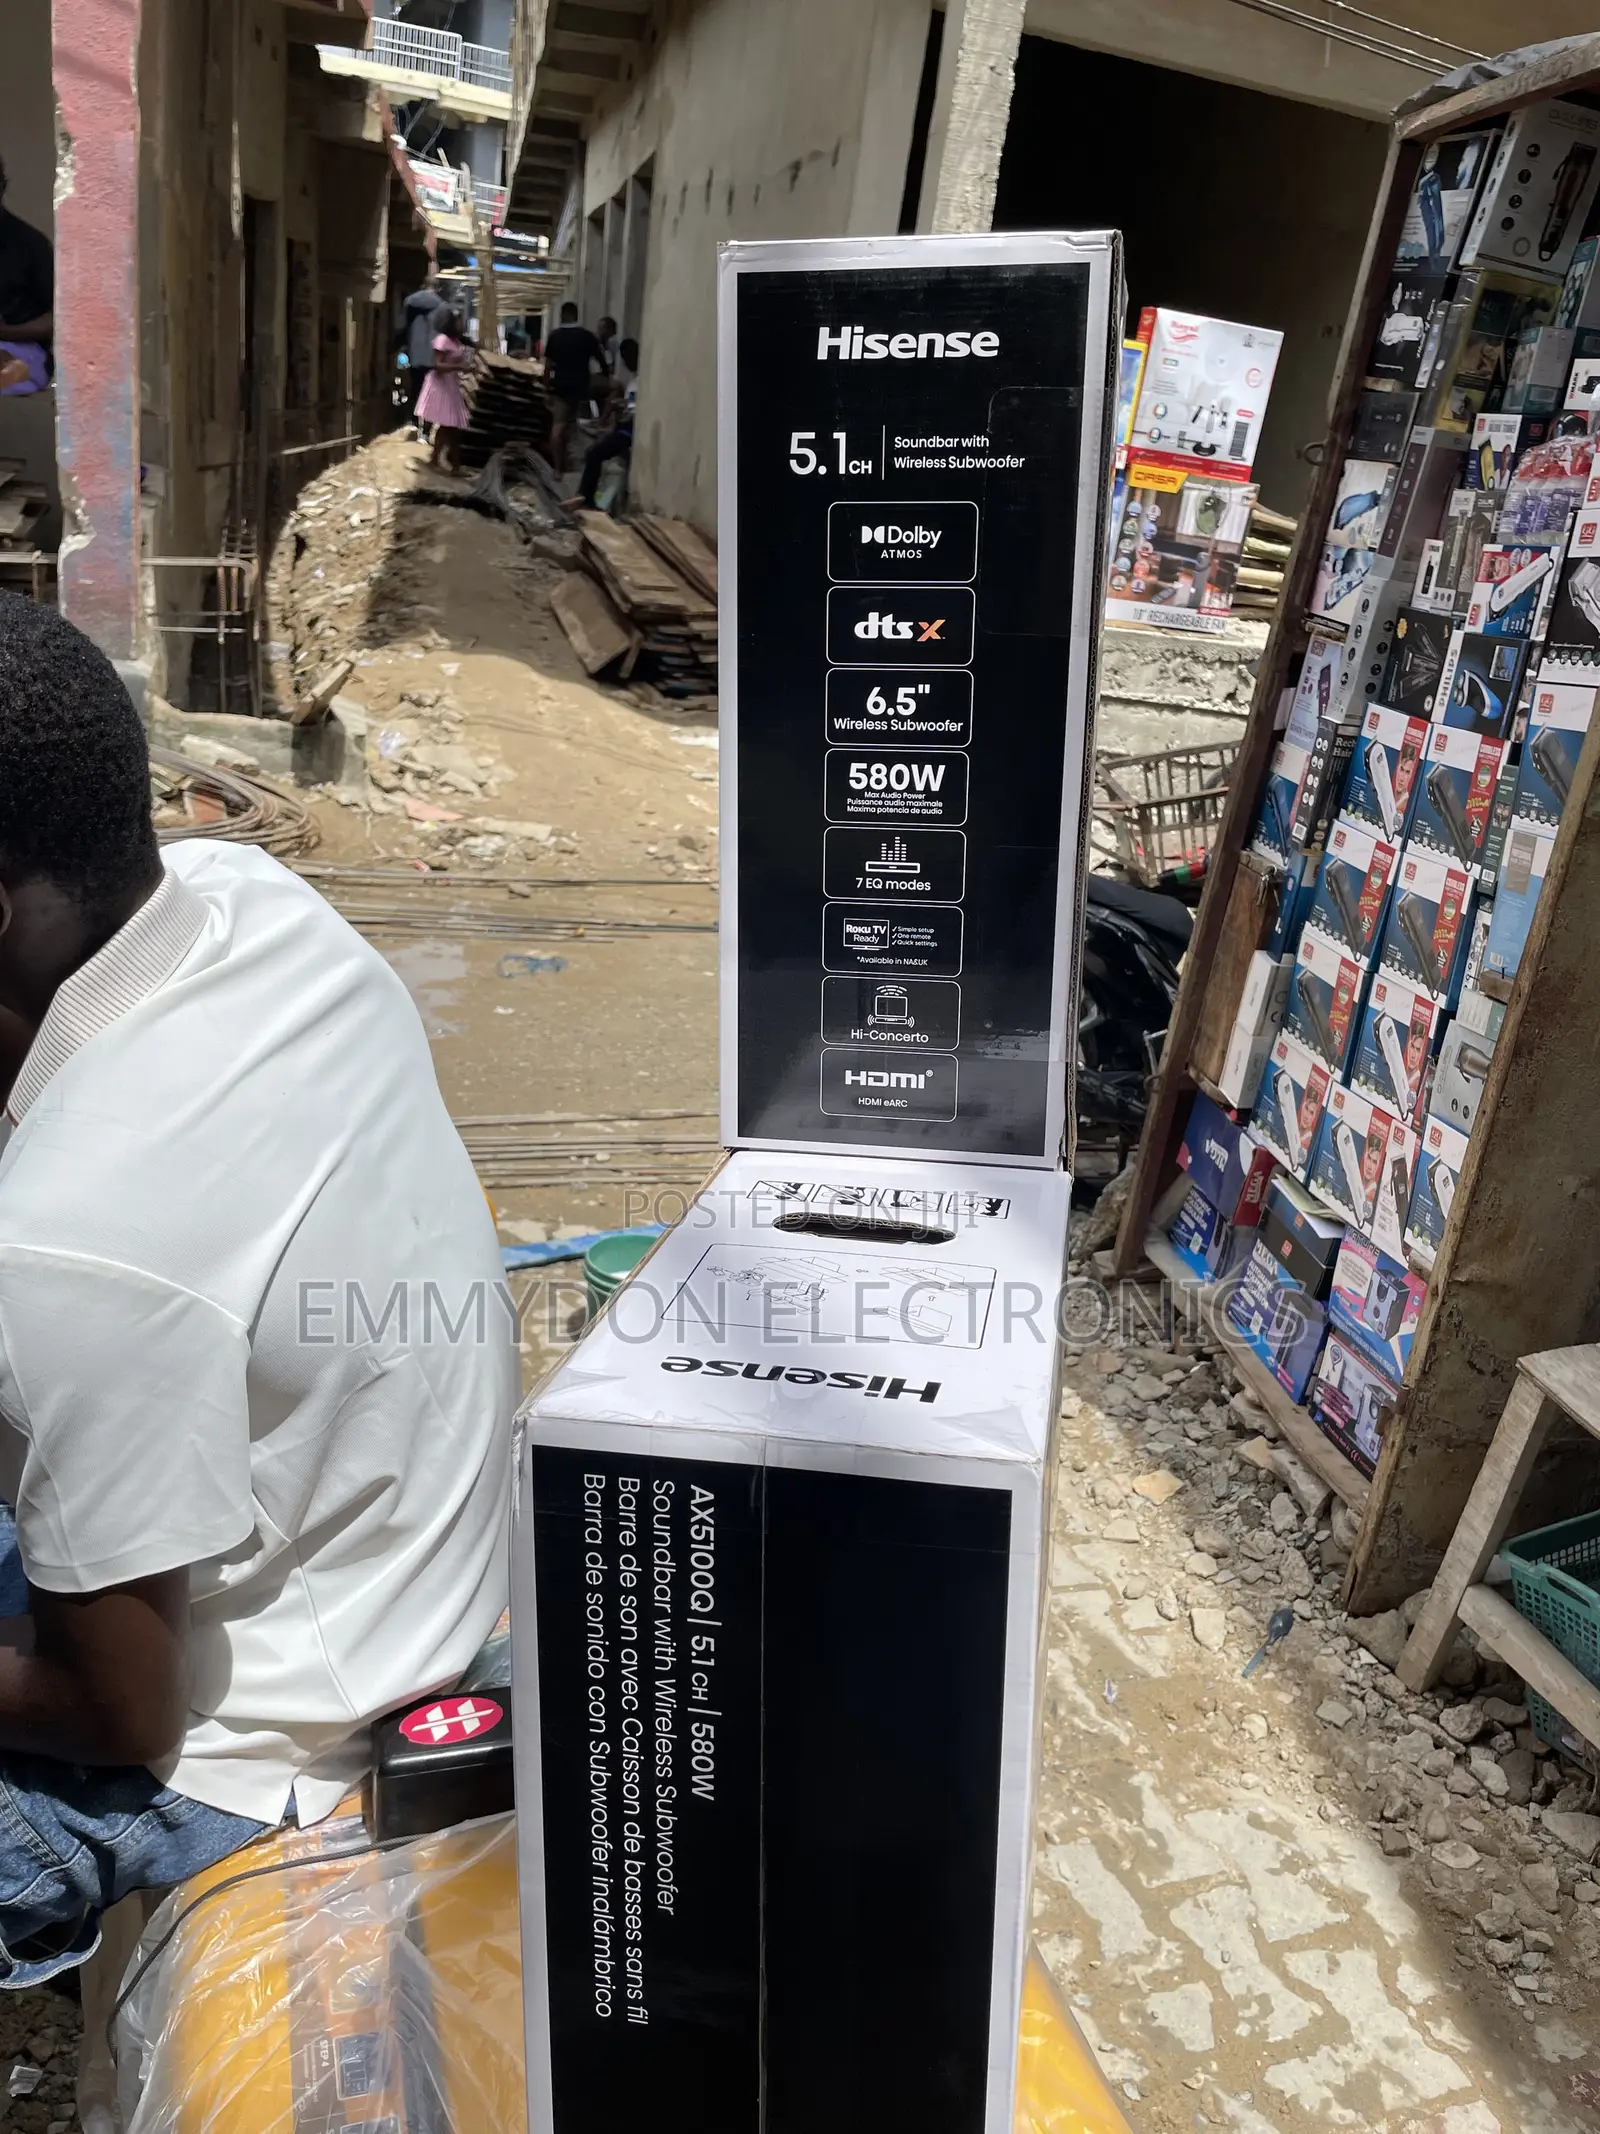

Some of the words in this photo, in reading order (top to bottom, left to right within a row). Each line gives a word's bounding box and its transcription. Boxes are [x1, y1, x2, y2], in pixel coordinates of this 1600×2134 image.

[817, 326, 999, 359] Hisense
[895, 436, 959, 448] Soundbar
[961, 435, 989, 447] with
[894, 456, 946, 468] Wireless
[949, 455, 1025, 468] Subwoofer
[888, 526, 942, 548] Dolby
[881, 550, 922, 558] ATMOS
[867, 684, 930, 715] 6.5"
[834, 718, 887, 730] Wireless
[891, 719, 963, 731] Subwoofer
[849, 763, 945, 791] 580W
[847, 798, 882, 806] Puissance
[877, 806, 909, 814] potencia
[856, 878, 863, 888] 7
[866, 878, 882, 889] EQ
[886, 879, 931, 890] modes
[846, 925, 871, 934] Roku
[873, 925, 886, 934] TV
[854, 934, 879, 944] Ready
[915, 940, 937, 948] settings
[903, 958, 928, 966] NA&UK
[851, 1029, 929, 1043] Hi-Concerto
[845, 1070, 925, 1089] HDMI
[884, 1099, 907, 1107] eARC
[660, 1355, 942, 1404] Hisense
[584, 1474, 605, 1544] Barra
[619, 1477, 640, 1546] Barre
[653, 1480, 676, 1613] Soundbar
[691, 1484, 714, 1612] AX5100Q
[586, 1552, 608, 1585] de
[620, 1554, 642, 1587] de
[620, 1595, 637, 1640] son
[586, 1593, 609, 1678] sonido
[655, 1619, 676, 1670] with
[691, 1636, 714, 1666] 5.1
[621, 1649, 638, 1710] avec
[692, 1673, 708, 1700] CH
[589, 1686, 605, 1732] con
[655, 1680, 677, 1777] Wireless
[622, 1718, 644, 1814] Caisson
[691, 1723, 714, 1800] 580W
[590, 1741, 613, 1872] Subwoofer
[624, 1822, 645, 1852] de
[656, 1785, 678, 1915] Subwoofer
[625, 1860, 645, 1940] basses
[593, 1877, 616, 2017] inalámbrico
[626, 1947, 642, 1999] sans
[628, 2006, 648, 2024] fil
